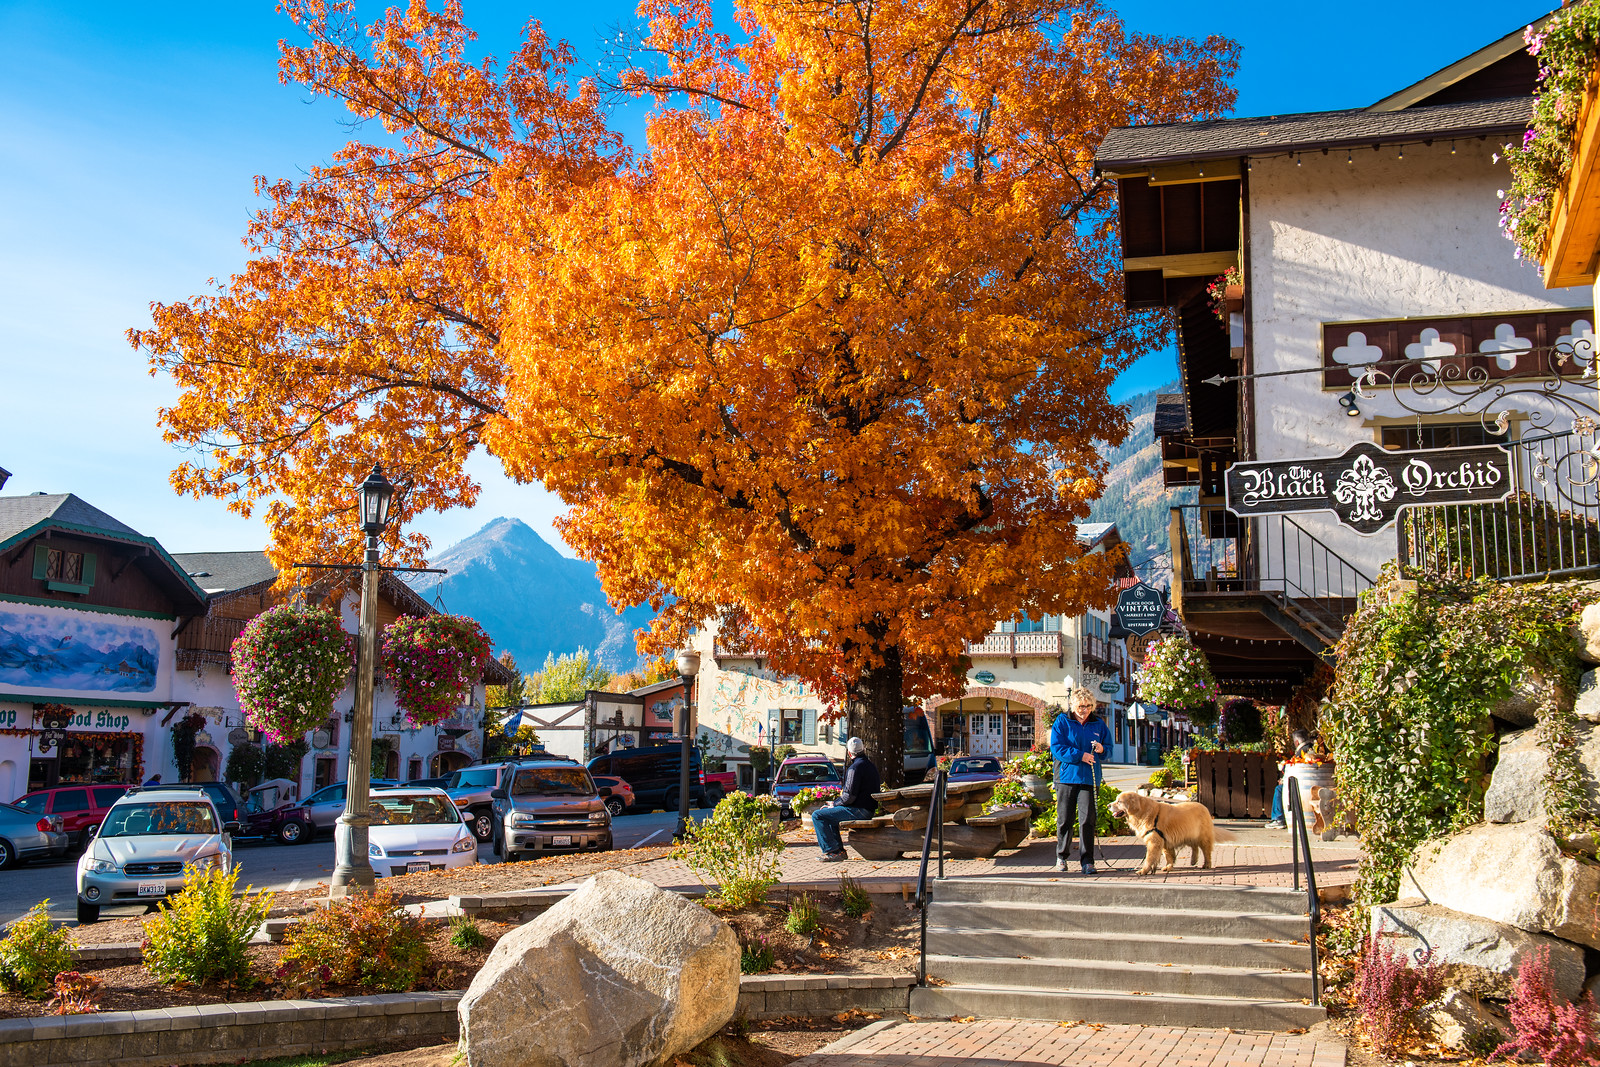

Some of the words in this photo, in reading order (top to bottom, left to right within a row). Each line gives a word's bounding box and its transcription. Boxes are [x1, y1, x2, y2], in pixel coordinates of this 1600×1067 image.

[1239, 467, 1327, 502] Black
[1402, 457, 1502, 496] Orchid
[1289, 465, 1312, 480] The
[68, 710, 92, 727] ood
[95, 709, 130, 730] Shop
